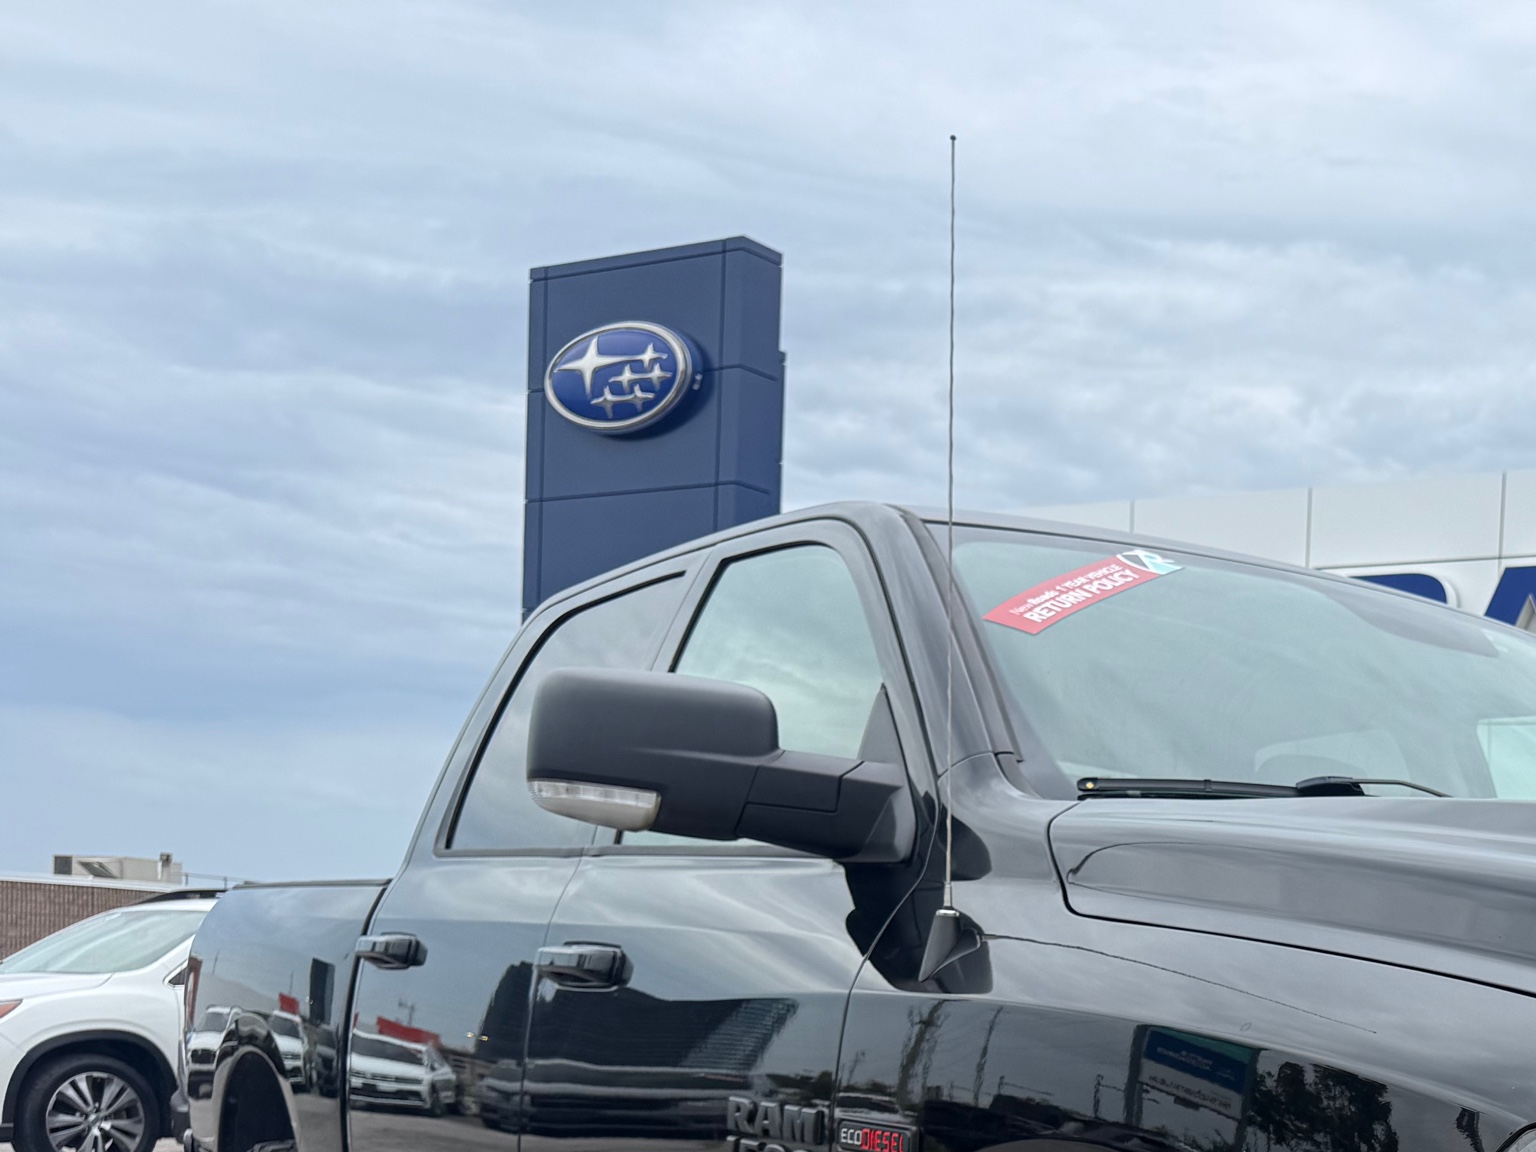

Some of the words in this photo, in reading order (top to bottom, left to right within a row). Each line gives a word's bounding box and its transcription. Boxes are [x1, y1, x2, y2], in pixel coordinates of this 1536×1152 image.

[1022, 588, 1093, 623] RETURN
[1086, 568, 1140, 595] POLICY
[1063, 575, 1090, 590] YEAR
[727, 1095, 825, 1145] RAM
